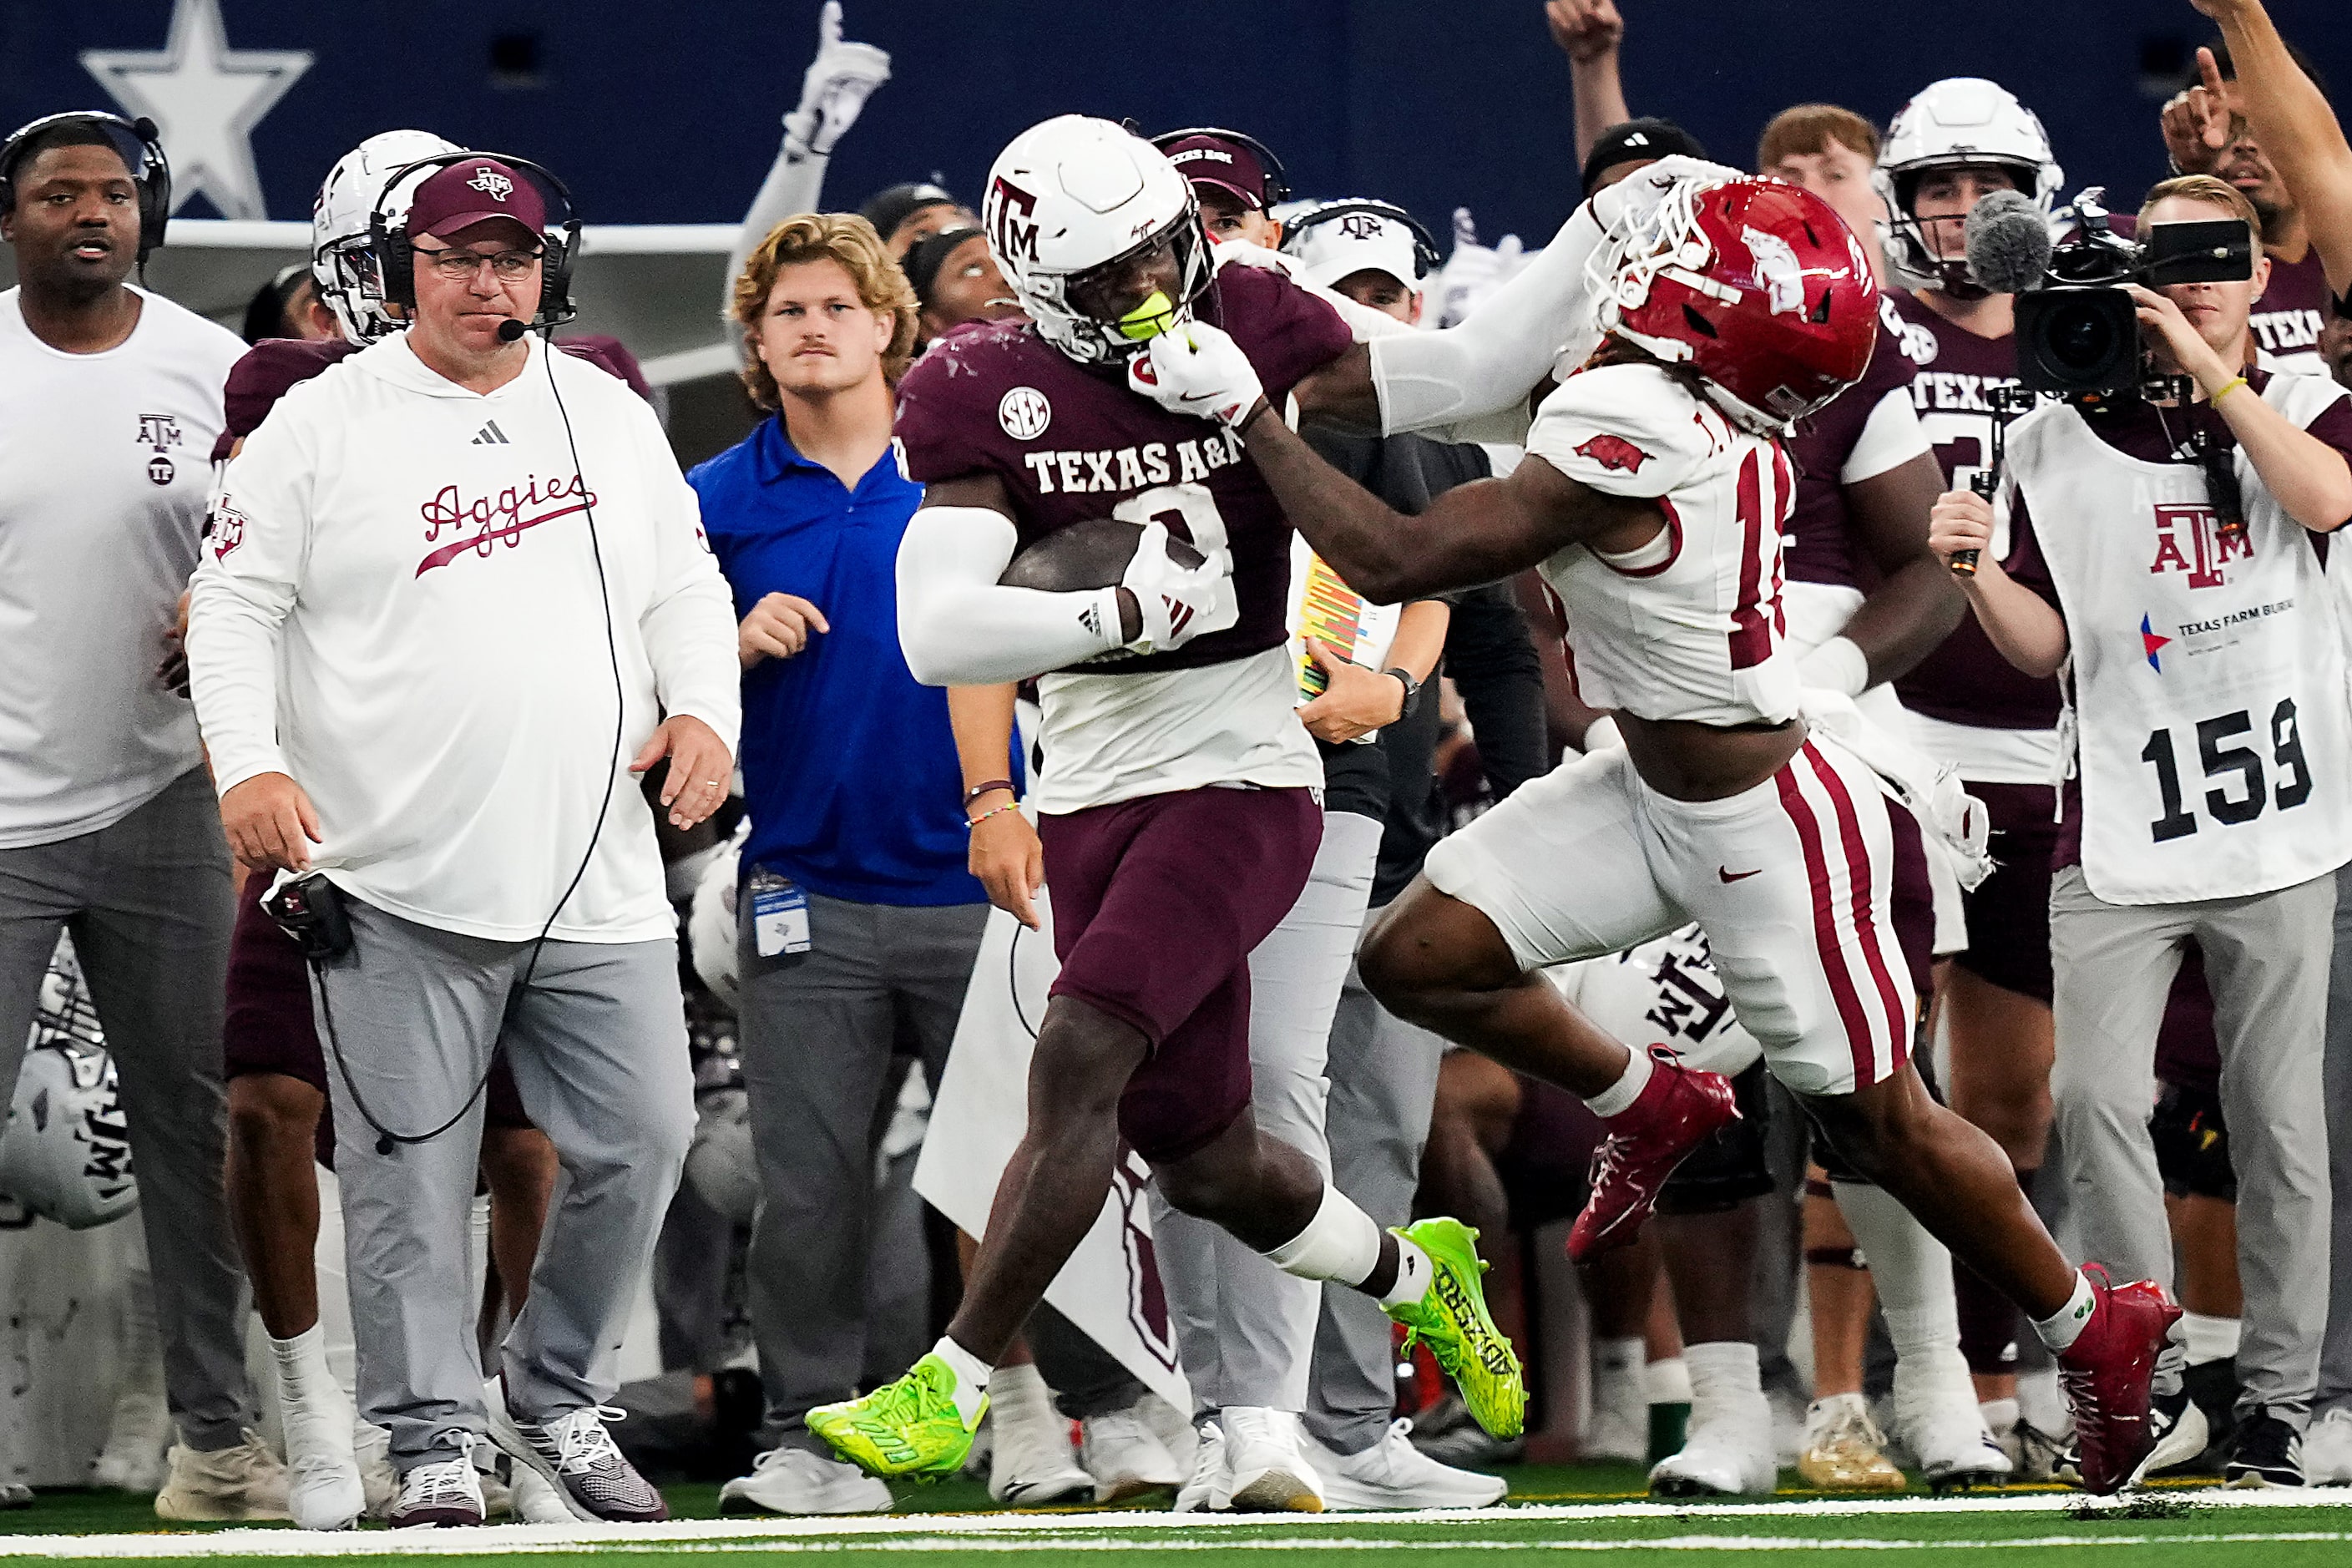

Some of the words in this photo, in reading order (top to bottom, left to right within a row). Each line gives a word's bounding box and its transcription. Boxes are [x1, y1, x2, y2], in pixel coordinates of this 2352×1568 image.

[1003, 391, 1048, 437] SEC
[1024, 443, 1170, 493] TEXAS
[421, 473, 597, 559] Aggies
[2178, 619, 2221, 637] TEXAS
[2223, 607, 2260, 627] FARM
[2142, 696, 2314, 844] 159
